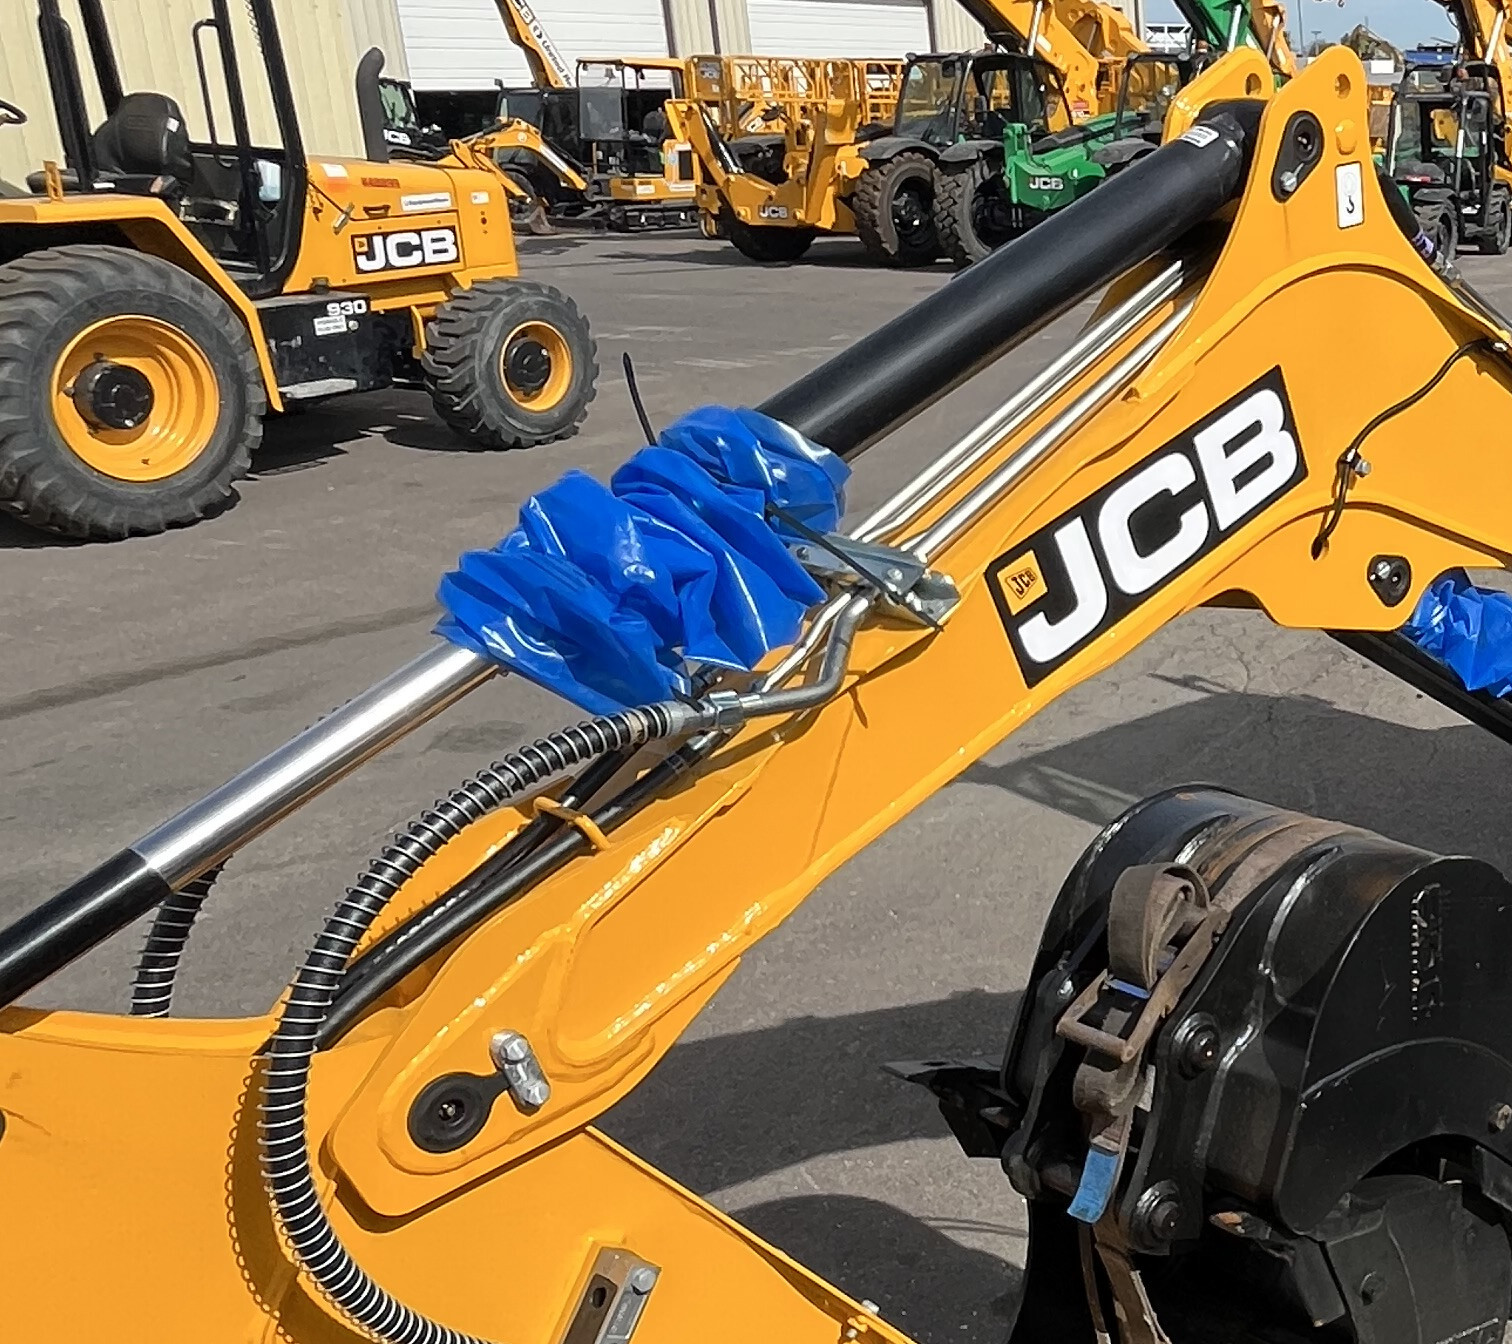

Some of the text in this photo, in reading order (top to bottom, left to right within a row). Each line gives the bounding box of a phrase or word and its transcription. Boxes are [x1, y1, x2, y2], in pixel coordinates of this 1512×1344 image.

[1029, 177, 1064, 190] JCB
[759, 206, 788, 218] JCB
[356, 228, 458, 272] JCB
[326, 299, 367, 316] 930
[1017, 388, 1298, 664] JCB
[1009, 569, 1037, 596] JCB
